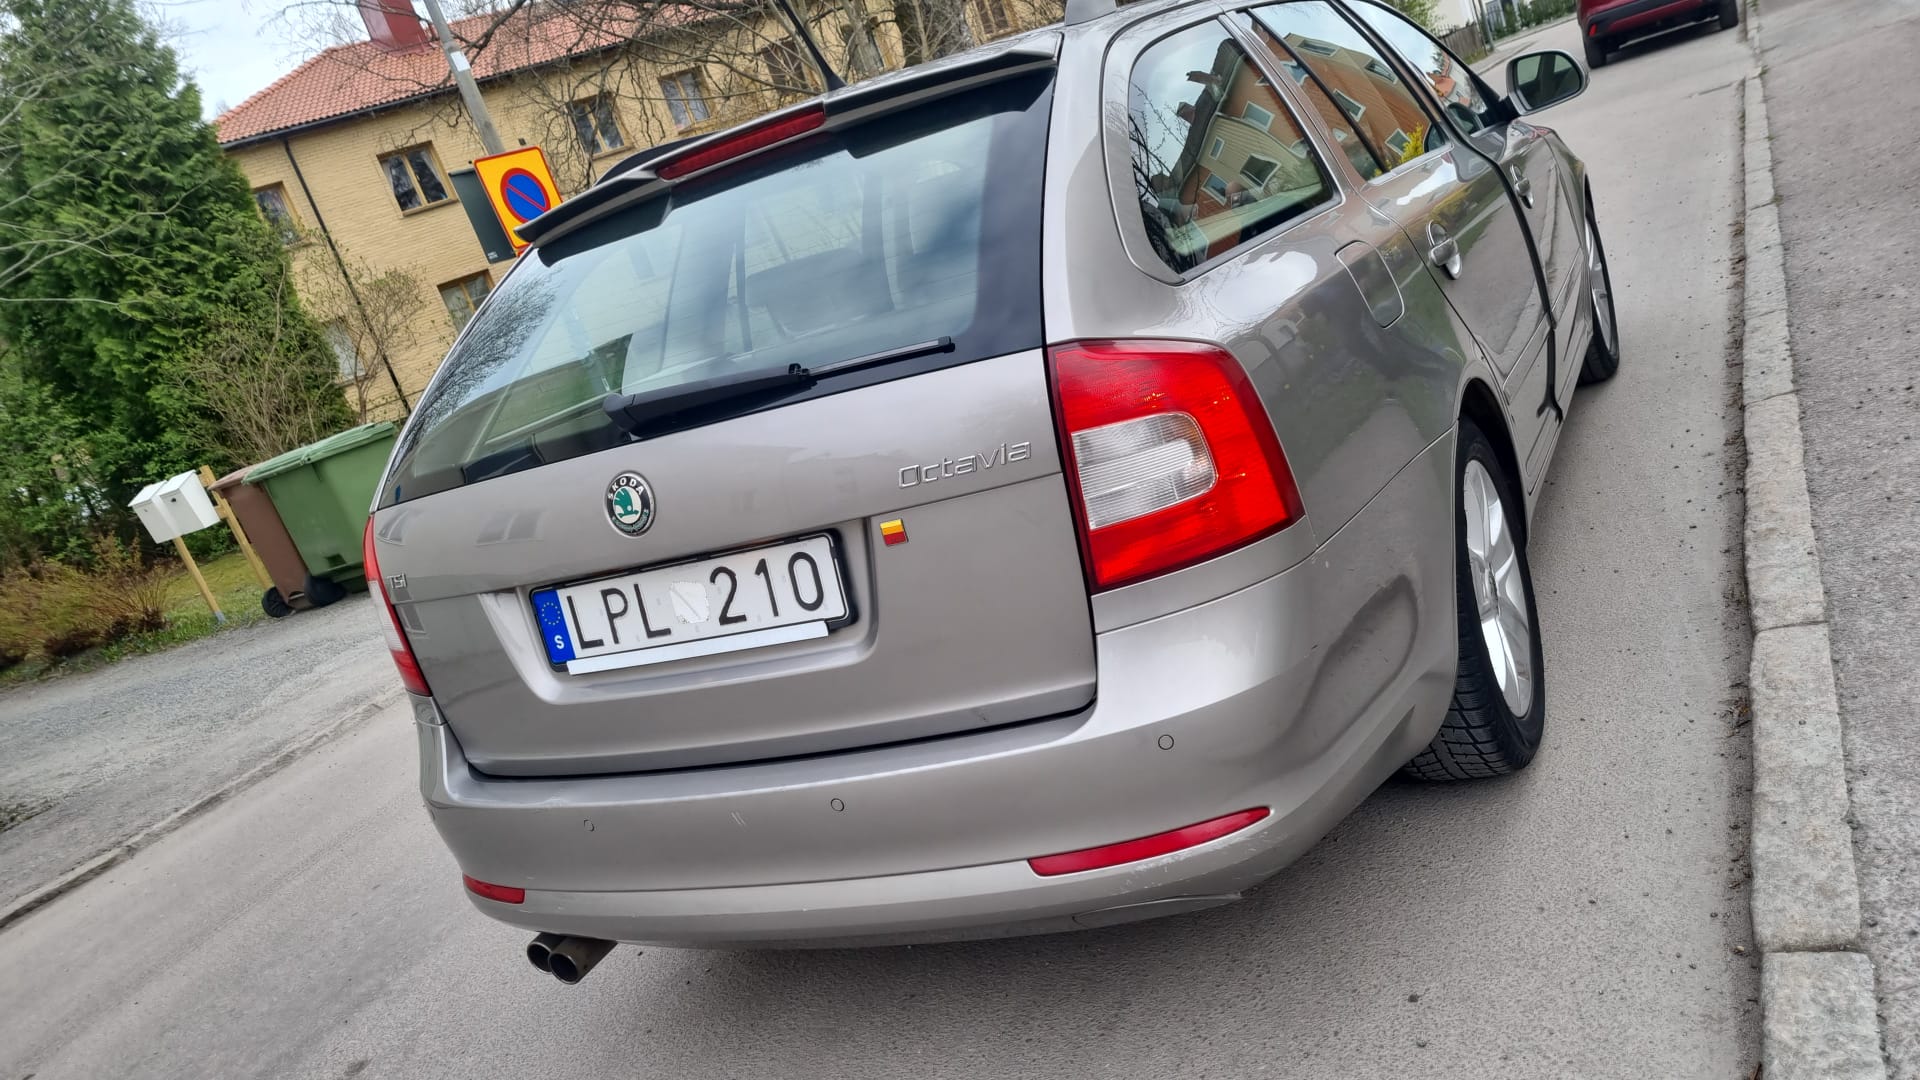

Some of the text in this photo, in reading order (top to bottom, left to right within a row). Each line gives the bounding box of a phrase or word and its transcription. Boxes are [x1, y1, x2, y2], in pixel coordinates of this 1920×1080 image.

[898, 441, 1031, 488] Octavia
[566, 551, 824, 649] LPL 210
[554, 635, 564, 649] S
